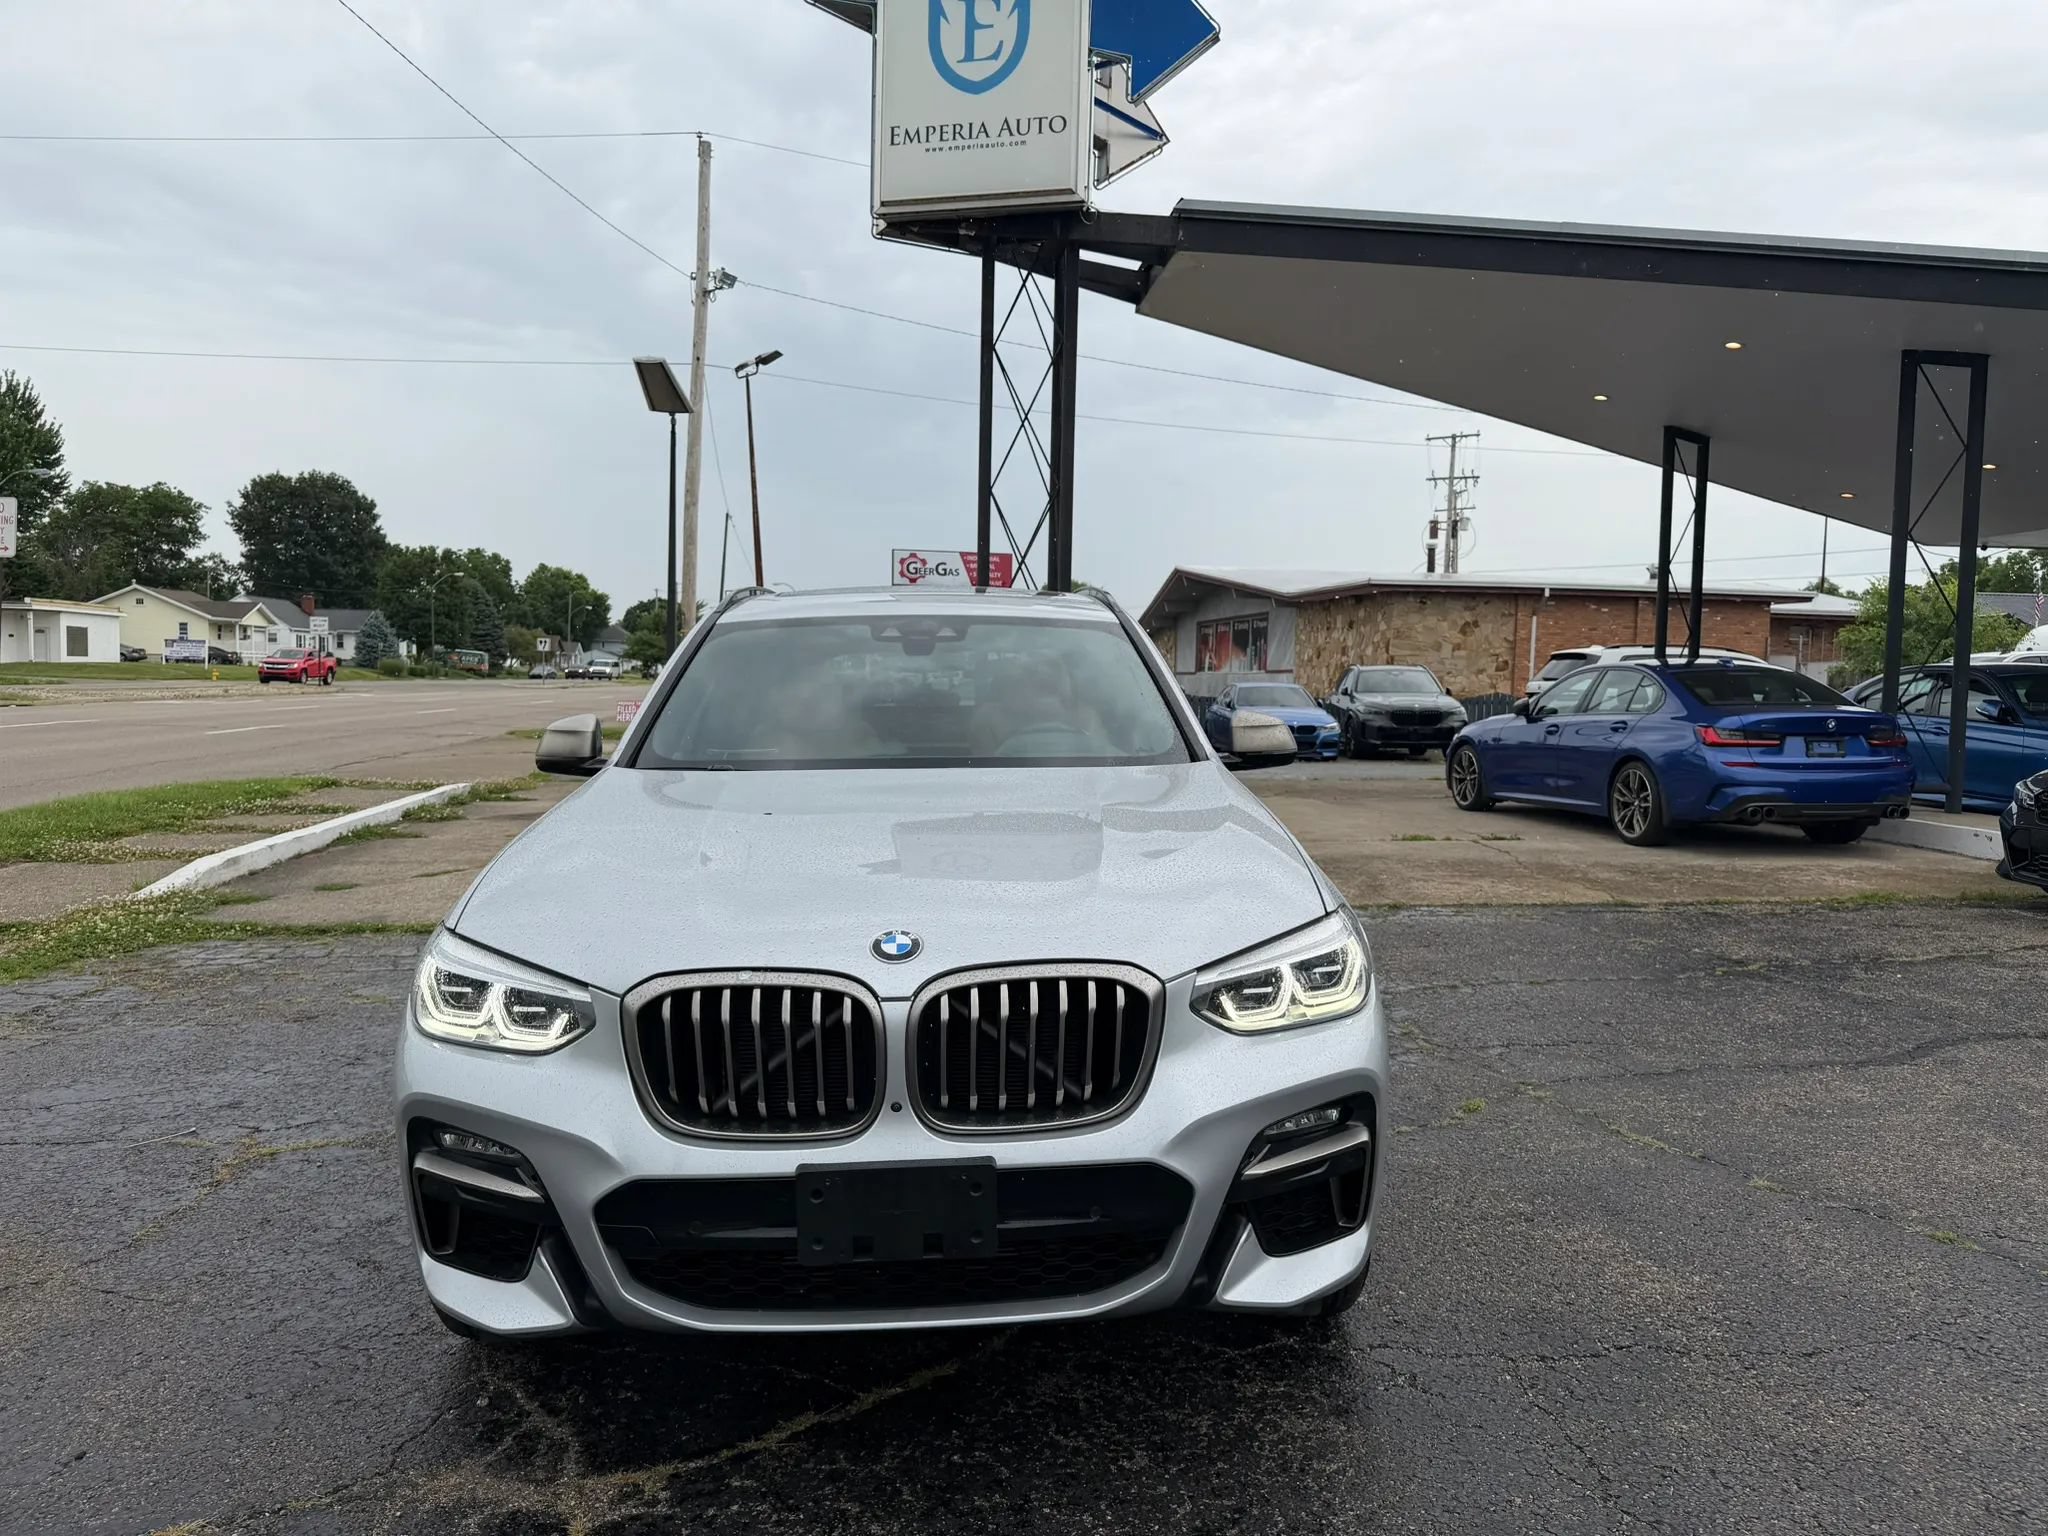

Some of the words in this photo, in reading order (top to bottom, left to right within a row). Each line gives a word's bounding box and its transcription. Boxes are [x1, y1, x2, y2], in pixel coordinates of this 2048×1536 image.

[889, 121, 990, 147] EMPERIA
[997, 115, 1067, 138] AUTO
[924, 139, 1027, 153] www.emperiaauto.com
